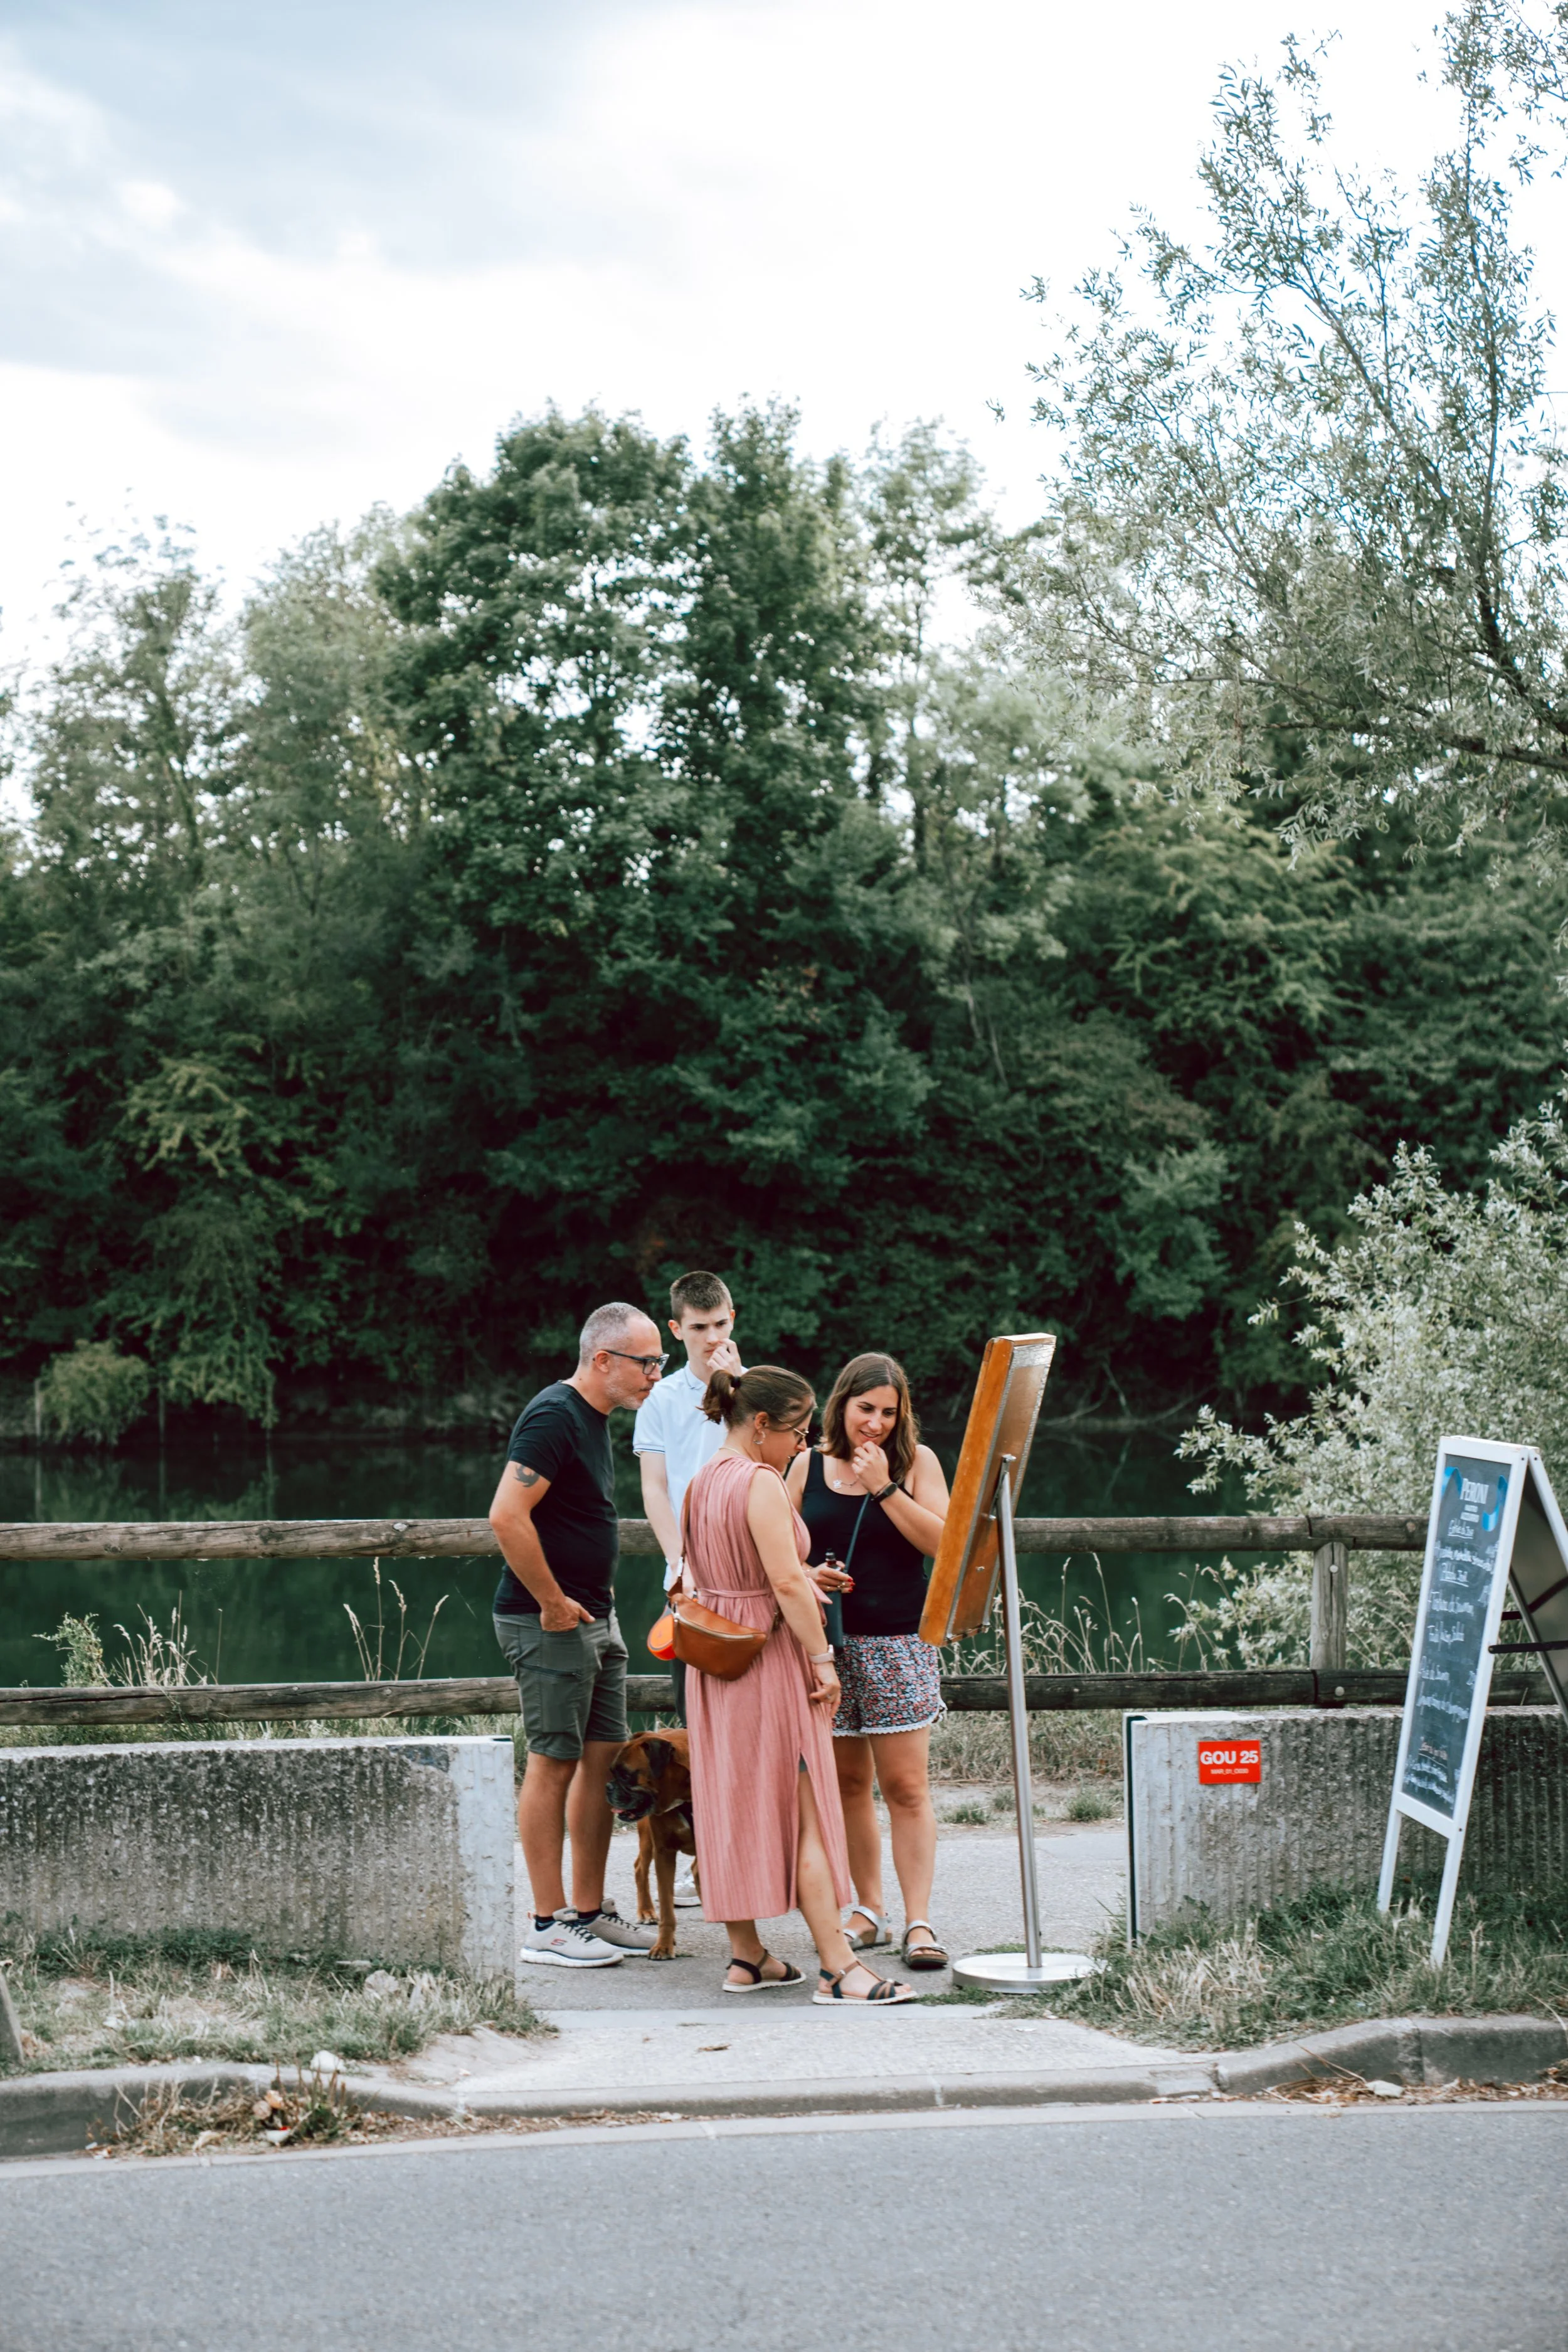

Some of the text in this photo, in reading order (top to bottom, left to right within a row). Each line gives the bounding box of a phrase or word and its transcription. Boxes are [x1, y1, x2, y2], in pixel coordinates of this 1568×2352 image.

[1459, 1478, 1490, 1504] PERONI
[1200, 1750, 1258, 1764] GOU 25
